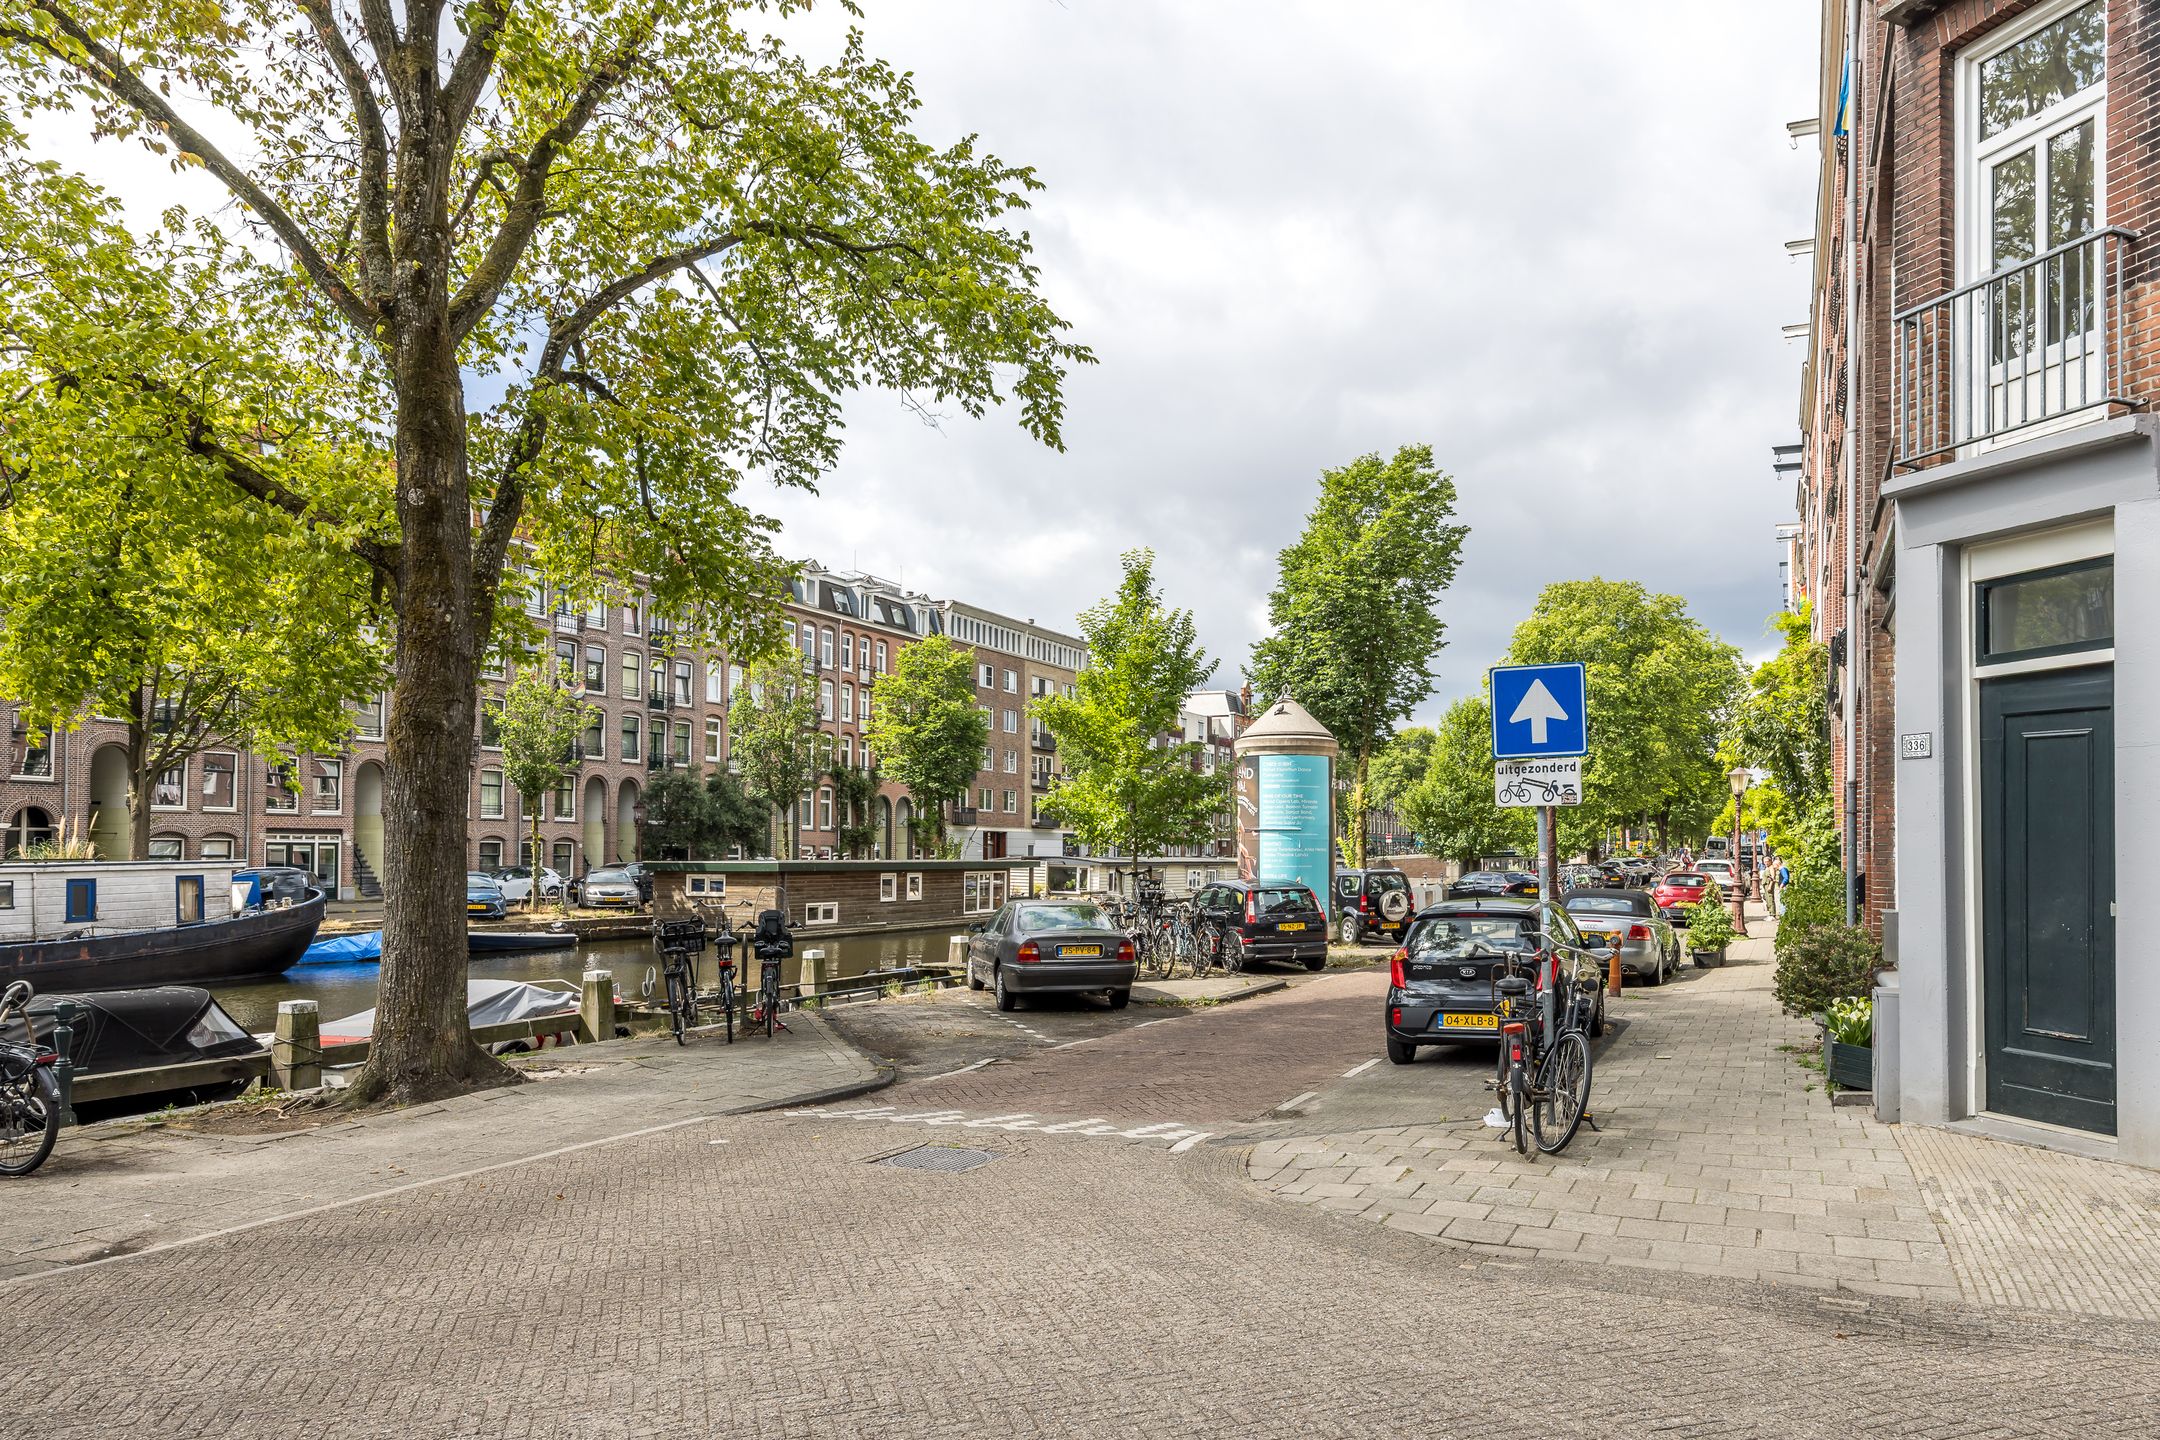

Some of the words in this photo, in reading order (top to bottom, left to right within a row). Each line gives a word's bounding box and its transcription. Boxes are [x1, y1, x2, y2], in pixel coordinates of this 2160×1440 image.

[1908, 740, 1925, 751] 336
[1497, 761, 1577, 777] uitgezonderd
[1446, 1015, 1494, 1026] 04-XLB-8
